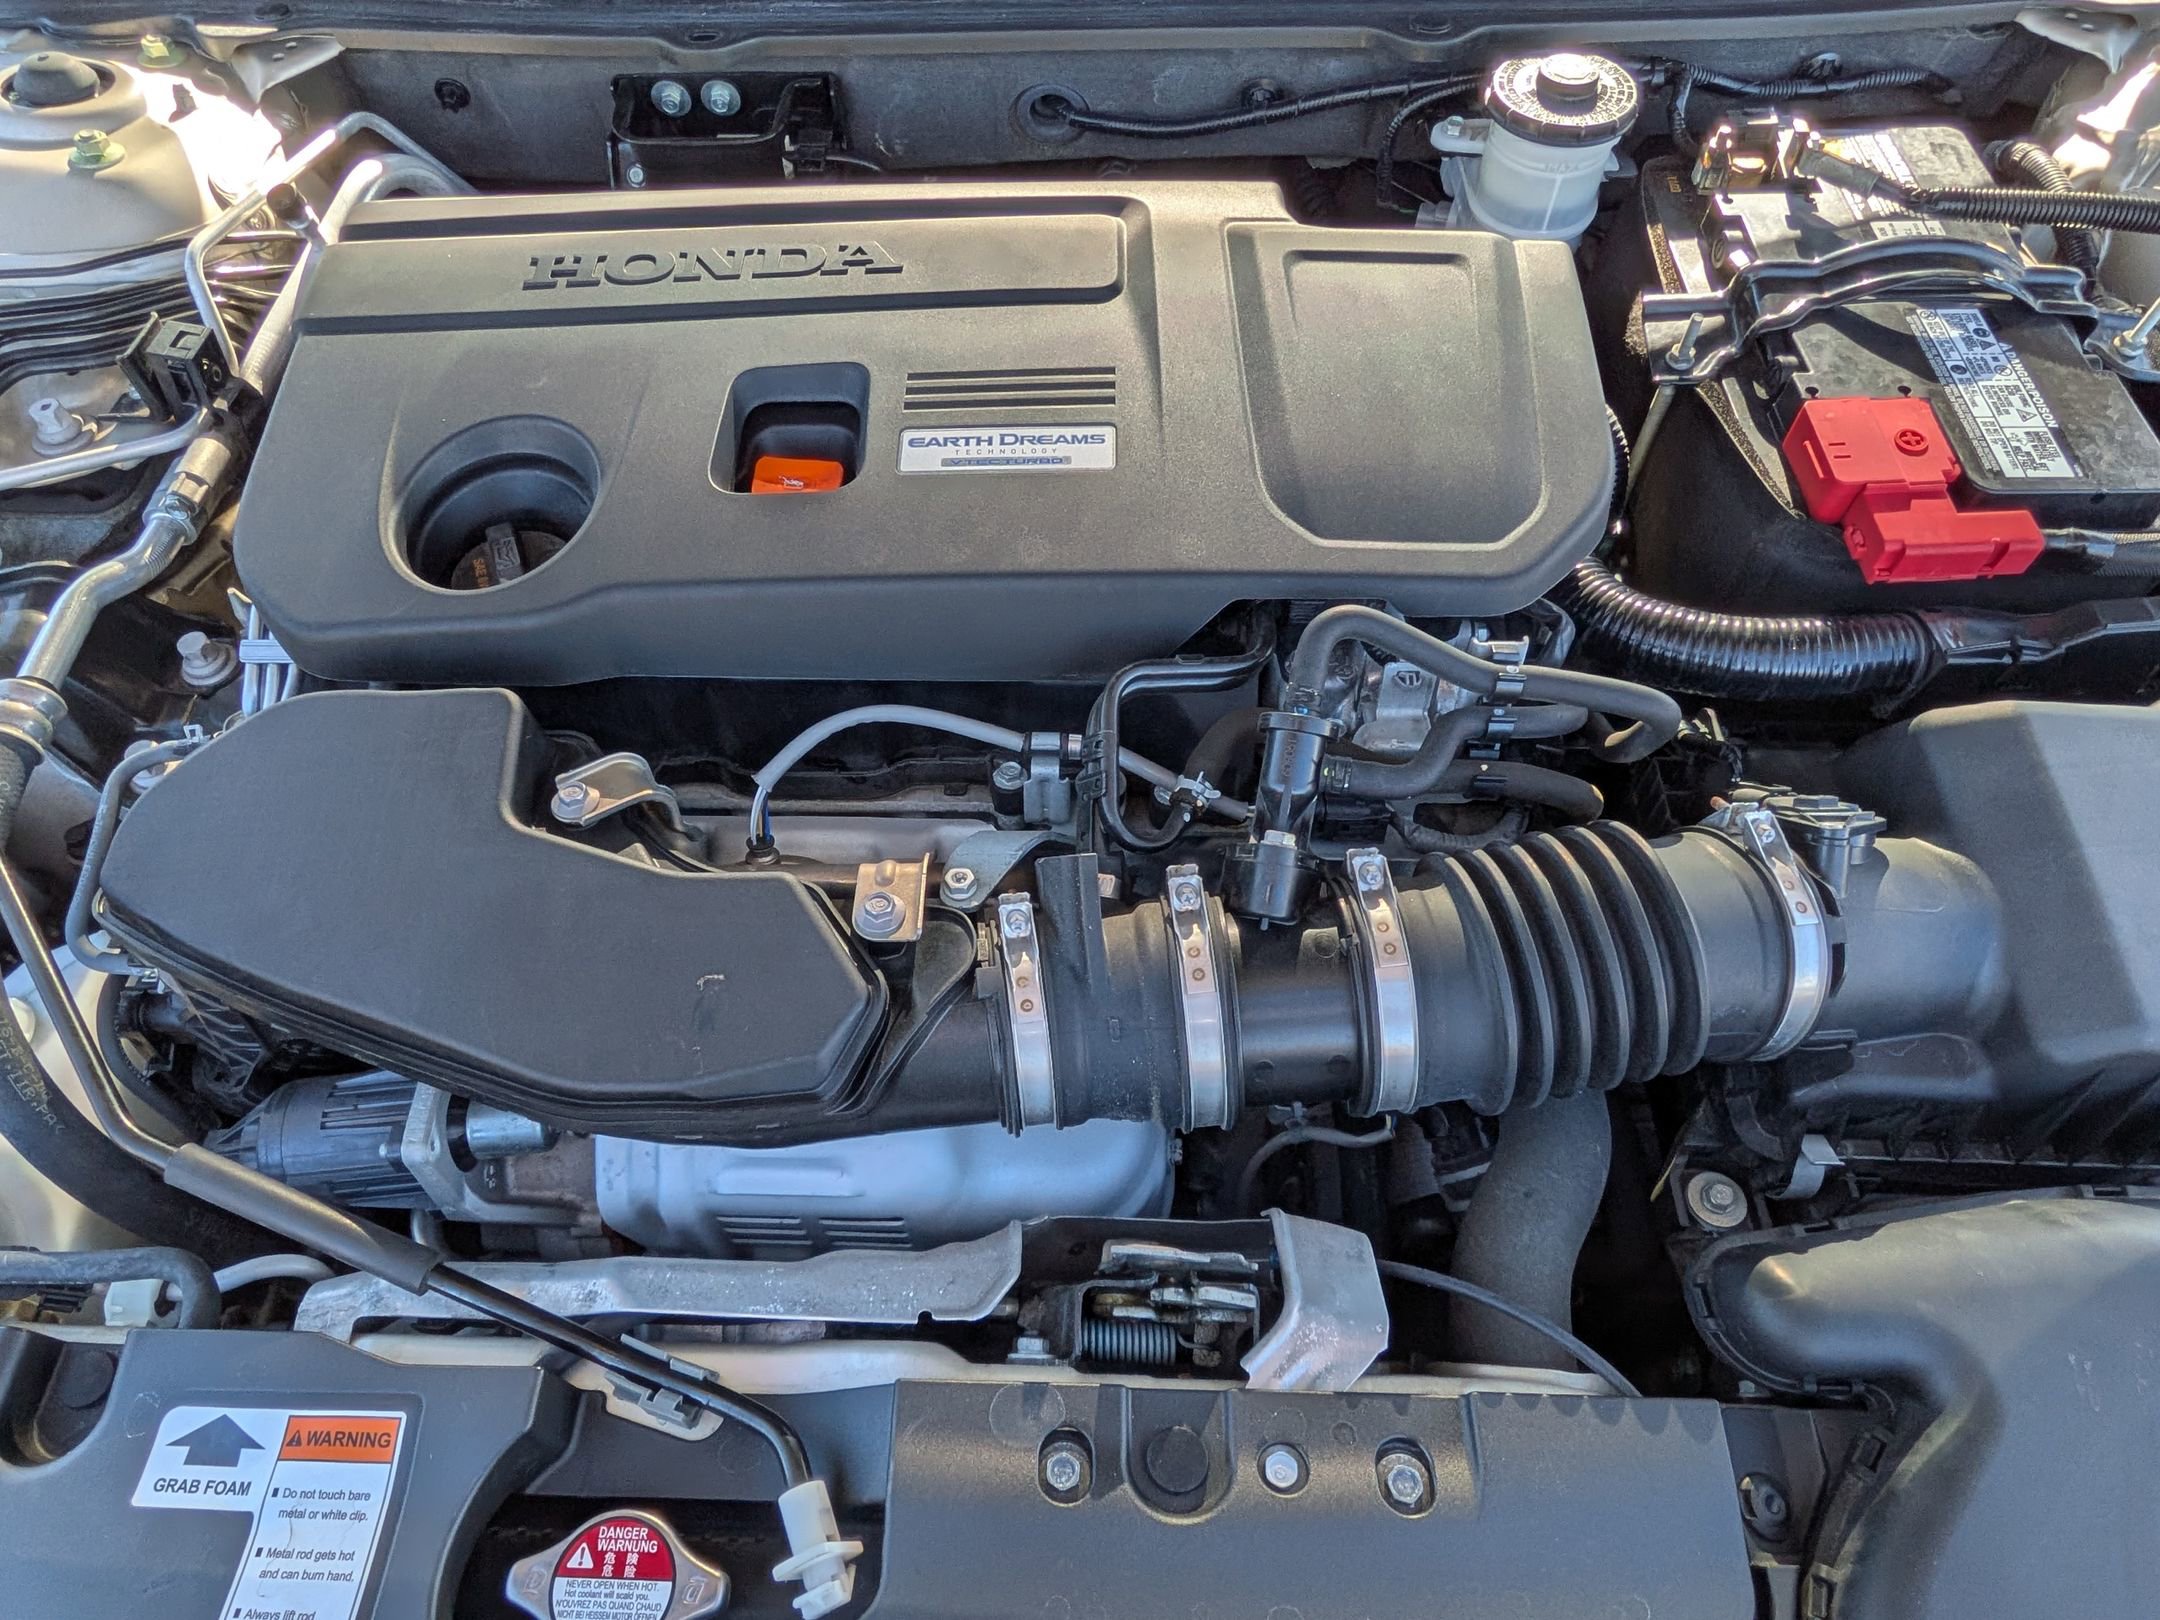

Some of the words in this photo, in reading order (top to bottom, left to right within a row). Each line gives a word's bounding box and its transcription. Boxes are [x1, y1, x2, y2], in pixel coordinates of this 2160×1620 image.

[522, 241, 903, 290] HONDA
[908, 436, 993, 448] EARTH
[1000, 433, 1106, 446] DREAMS
[306, 1430, 392, 1448] WARNING
[153, 1478, 201, 1494] GRAB
[204, 1479, 251, 1496] FOAM
[282, 1488, 298, 1499] Do
[300, 1488, 316, 1500] not
[318, 1489, 346, 1501] touch
[348, 1490, 371, 1501] bare
[278, 1508, 307, 1519] metal
[309, 1511, 320, 1520] or
[321, 1509, 348, 1521] white
[349, 1510, 369, 1523] clip.
[598, 1526, 648, 1540] DANGER
[597, 1539, 658, 1553] WARNUNG
[266, 1548, 295, 1559] Metal
[296, 1549, 313, 1560] rod
[314, 1550, 336, 1563] gets
[337, 1550, 355, 1561] hot
[258, 1568, 279, 1579] and
[280, 1571, 300, 1580] can
[301, 1569, 325, 1581] burn
[326, 1570, 355, 1582] hand.
[566, 1579, 592, 1589] NEVER
[593, 1580, 615, 1589] OPEN
[616, 1581, 640, 1591] WHEN
[641, 1582, 660, 1592] HOT.
[564, 1588, 577, 1598] Hot
[577, 1589, 602, 1599] coolant
[603, 1590, 614, 1599] will
[616, 1591, 634, 1600] scald
[555, 1599, 592, 1609] N'OUVREZ
[592, 1601, 607, 1609] PAS
[608, 1602, 634, 1611] QUAND
[635, 1603, 662, 1612] CHAUD.
[243, 1609, 281, 1620] Always
[282, 1610, 298, 1620] lift
[299, 1611, 316, 1620] rod
[557, 1609, 575, 1619] NICHT
[575, 1610, 585, 1620] BEI
[612, 1612, 634, 1620] MOTOR
